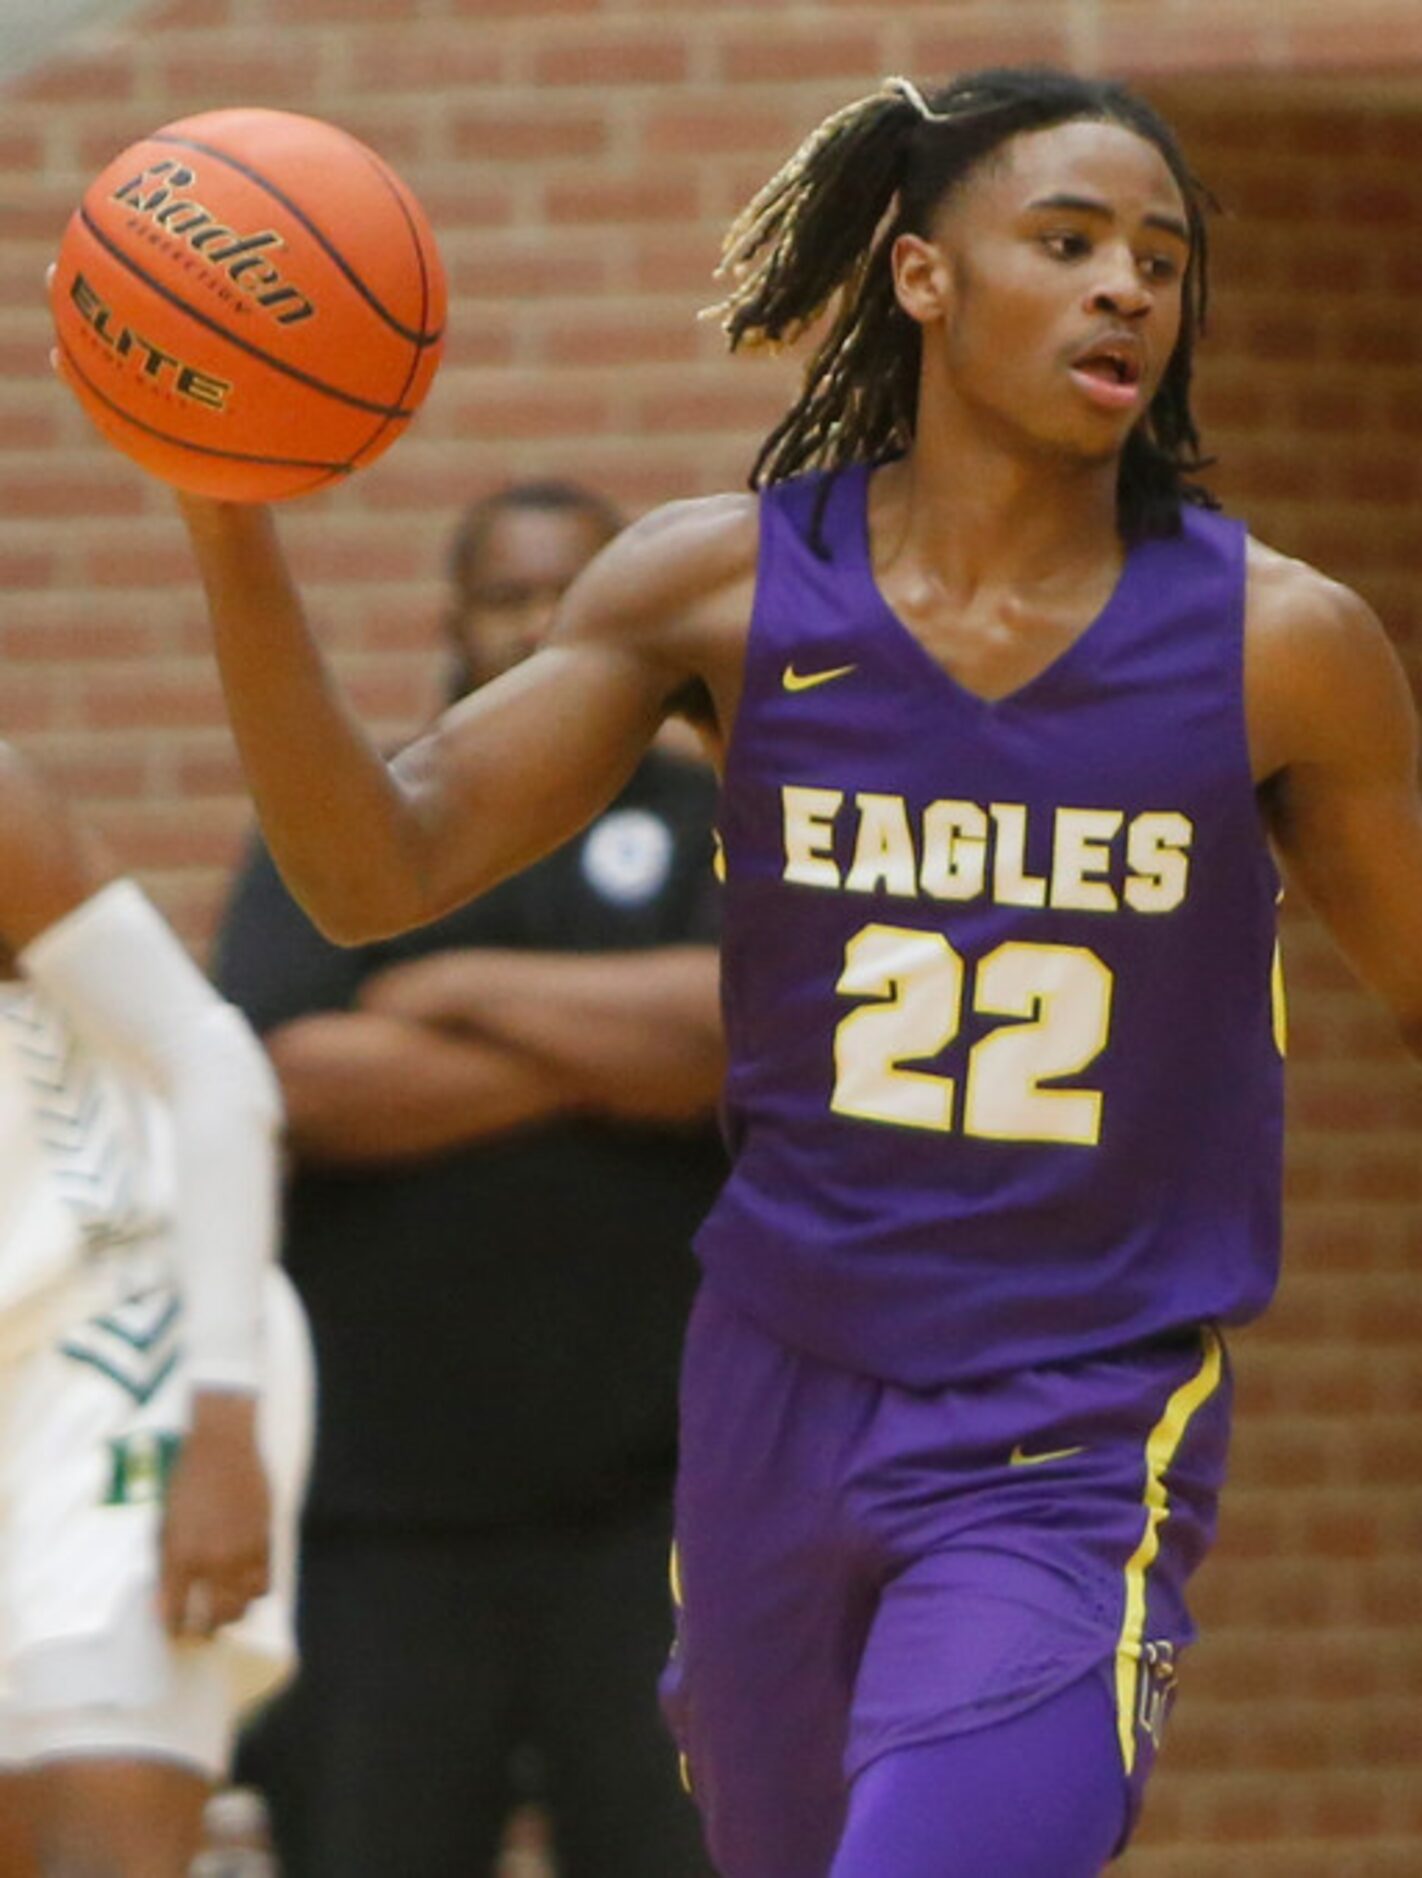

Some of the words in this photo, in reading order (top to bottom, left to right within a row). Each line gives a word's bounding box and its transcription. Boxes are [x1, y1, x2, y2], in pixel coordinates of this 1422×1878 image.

[110, 159, 316, 326] Baden
[70, 271, 231, 411] ELITE
[781, 785, 1194, 912] EAGLES
[829, 922, 1114, 1146] 22
